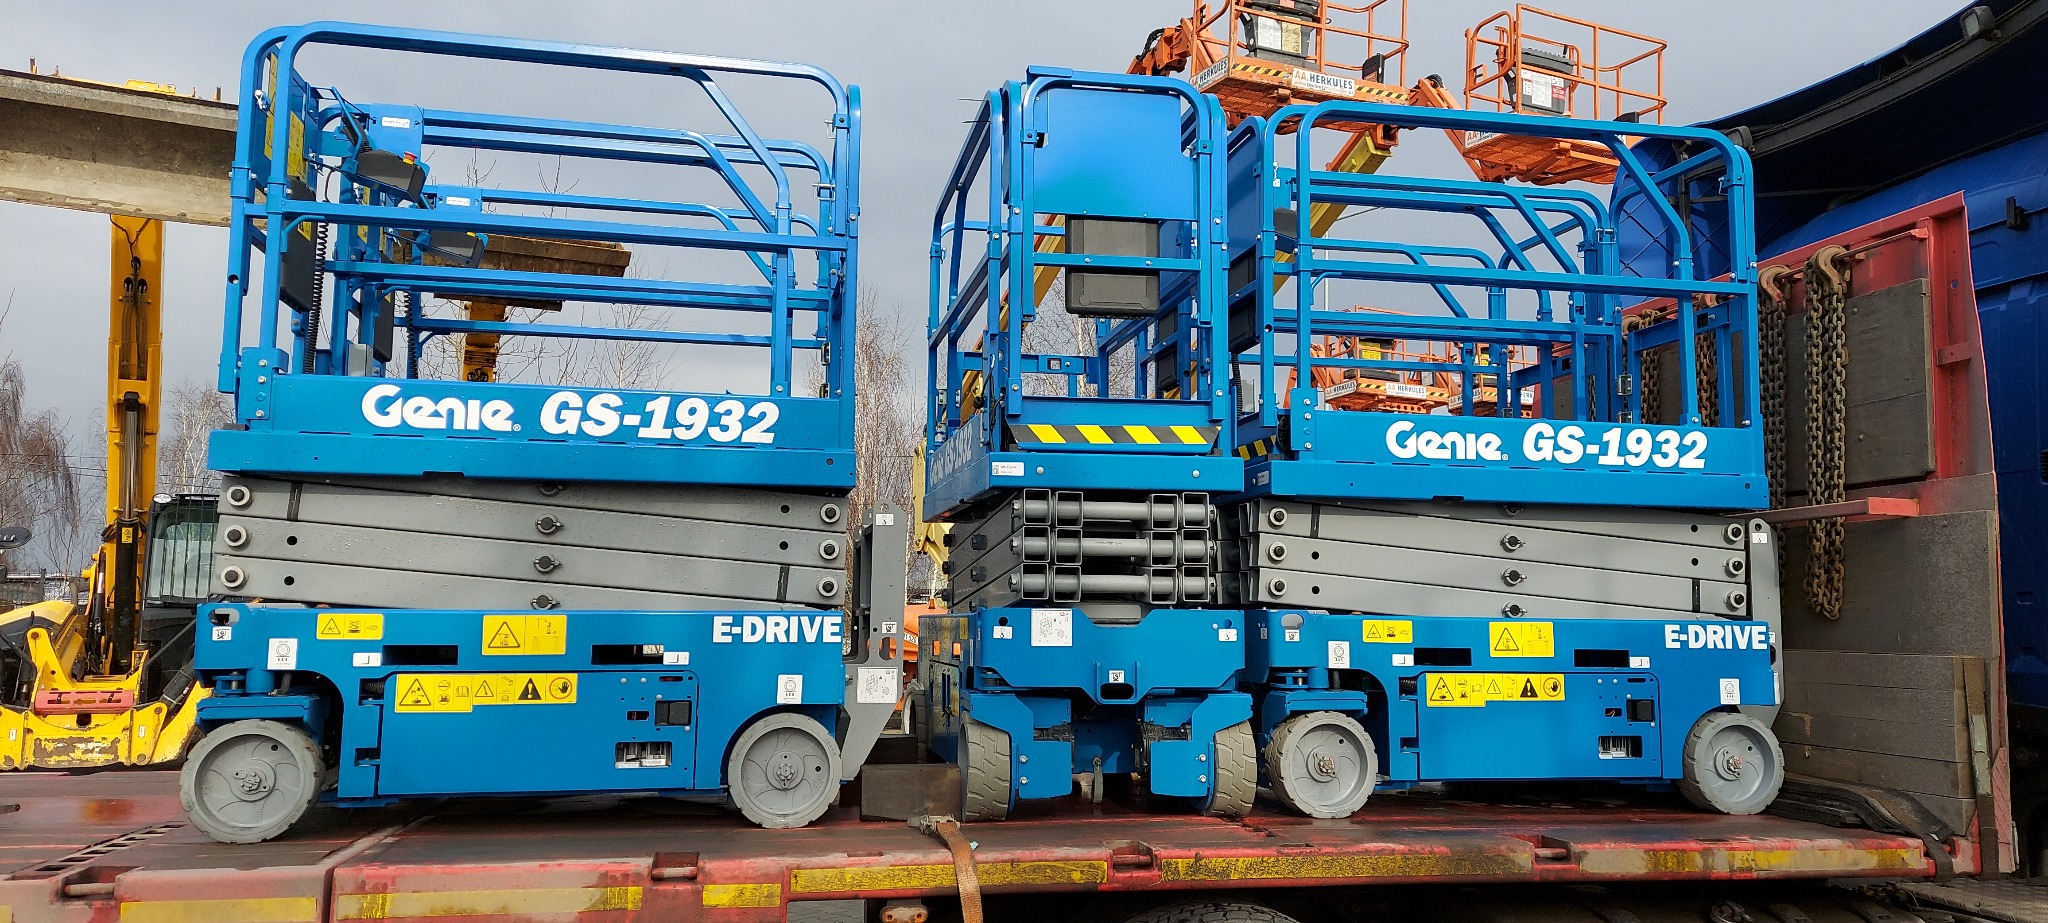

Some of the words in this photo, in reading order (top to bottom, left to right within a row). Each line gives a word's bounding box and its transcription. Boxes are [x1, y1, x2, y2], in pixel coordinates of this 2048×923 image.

[1309, 73, 1353, 90] HERKULES
[1397, 384, 1425, 394] HERKULES
[362, 385, 511, 431] Genie
[540, 391, 779, 443] GS-1932
[1386, 421, 1501, 460] Genie
[1523, 423, 1707, 468] GS-1932
[713, 616, 841, 642] E-DRIVE
[1665, 625, 1767, 649] E-DRIVE
